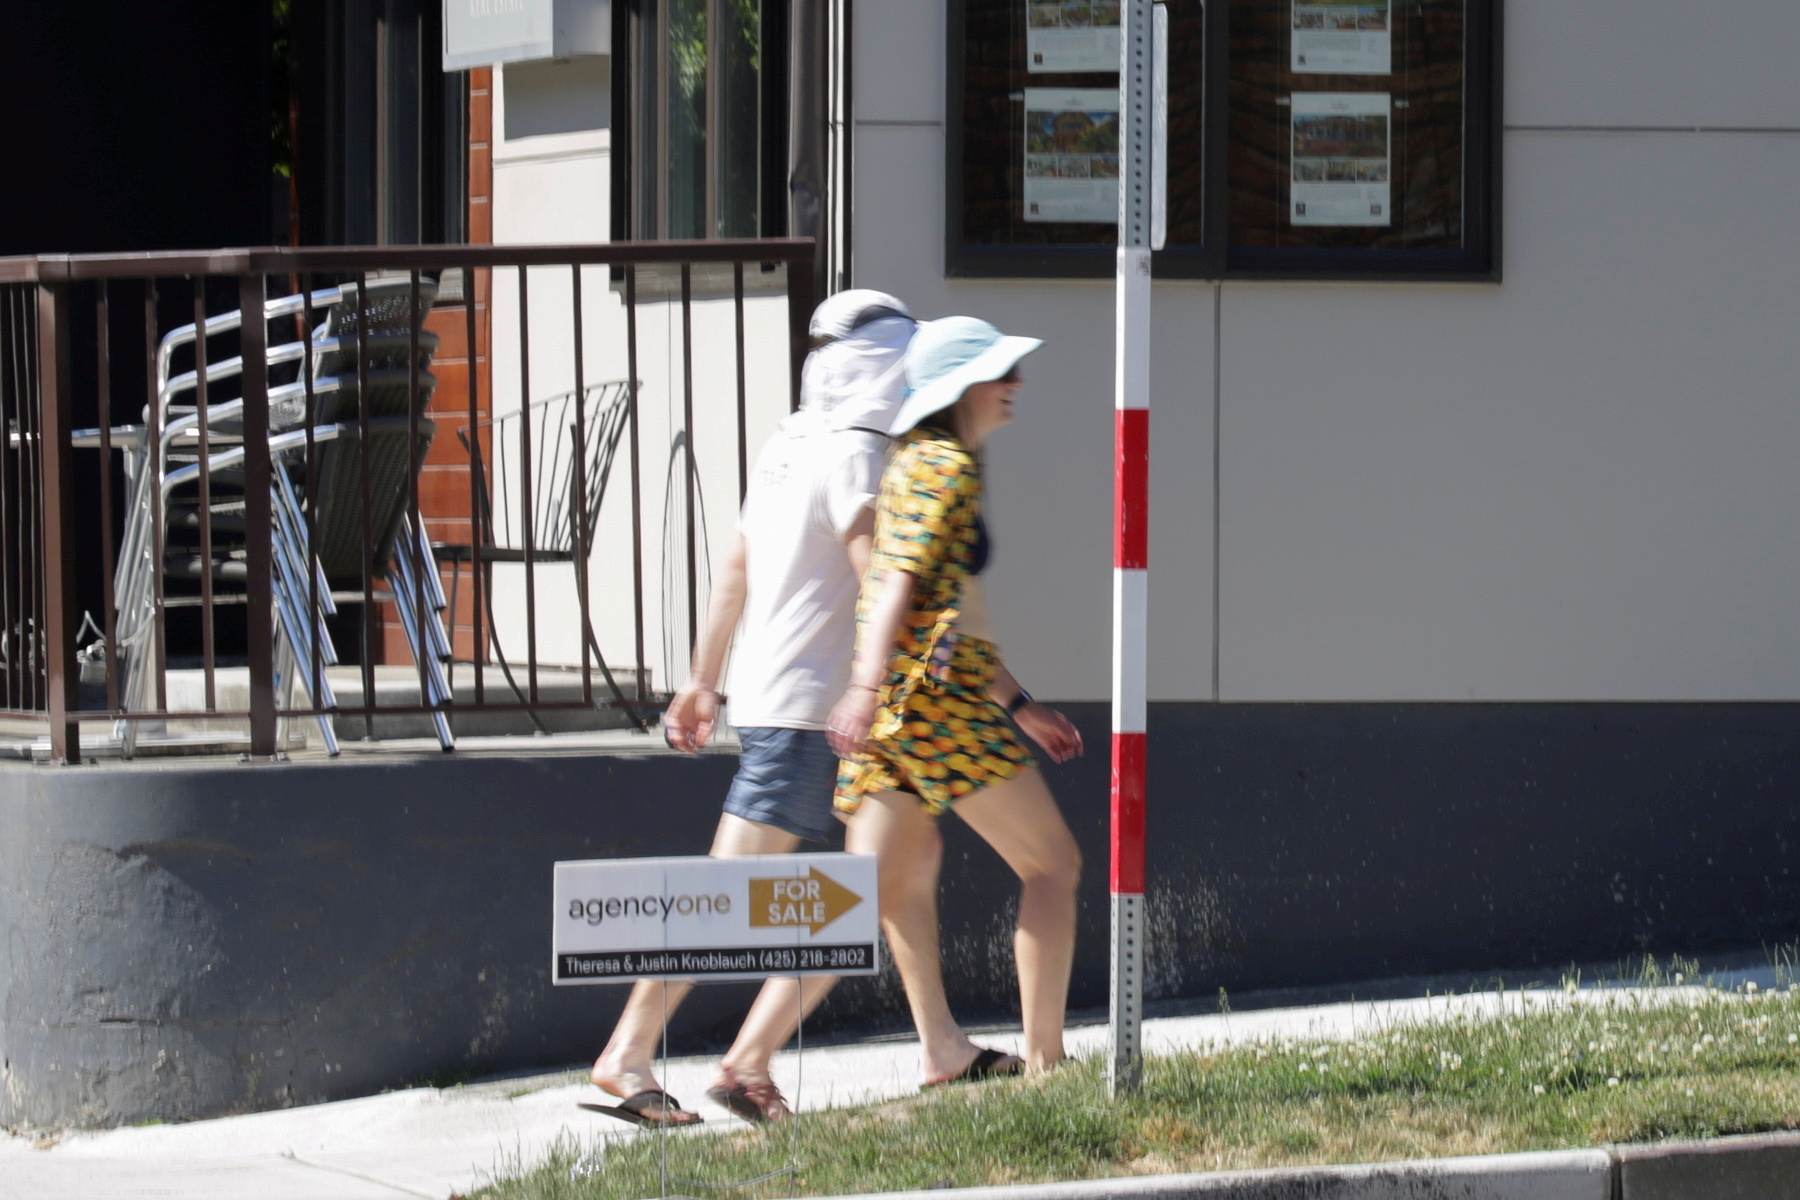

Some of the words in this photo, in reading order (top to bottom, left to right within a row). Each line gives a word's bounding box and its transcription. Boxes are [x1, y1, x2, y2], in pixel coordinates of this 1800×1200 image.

[773, 879, 821, 901] FOR
[568, 892, 732, 927] agencyone
[767, 901, 826, 924] SALE
[565, 956, 621, 975] Theresa
[623, 954, 634, 973] &
[636, 952, 679, 972] Justin
[681, 951, 757, 971] Knoblauch
[759, 949, 797, 970] (425)
